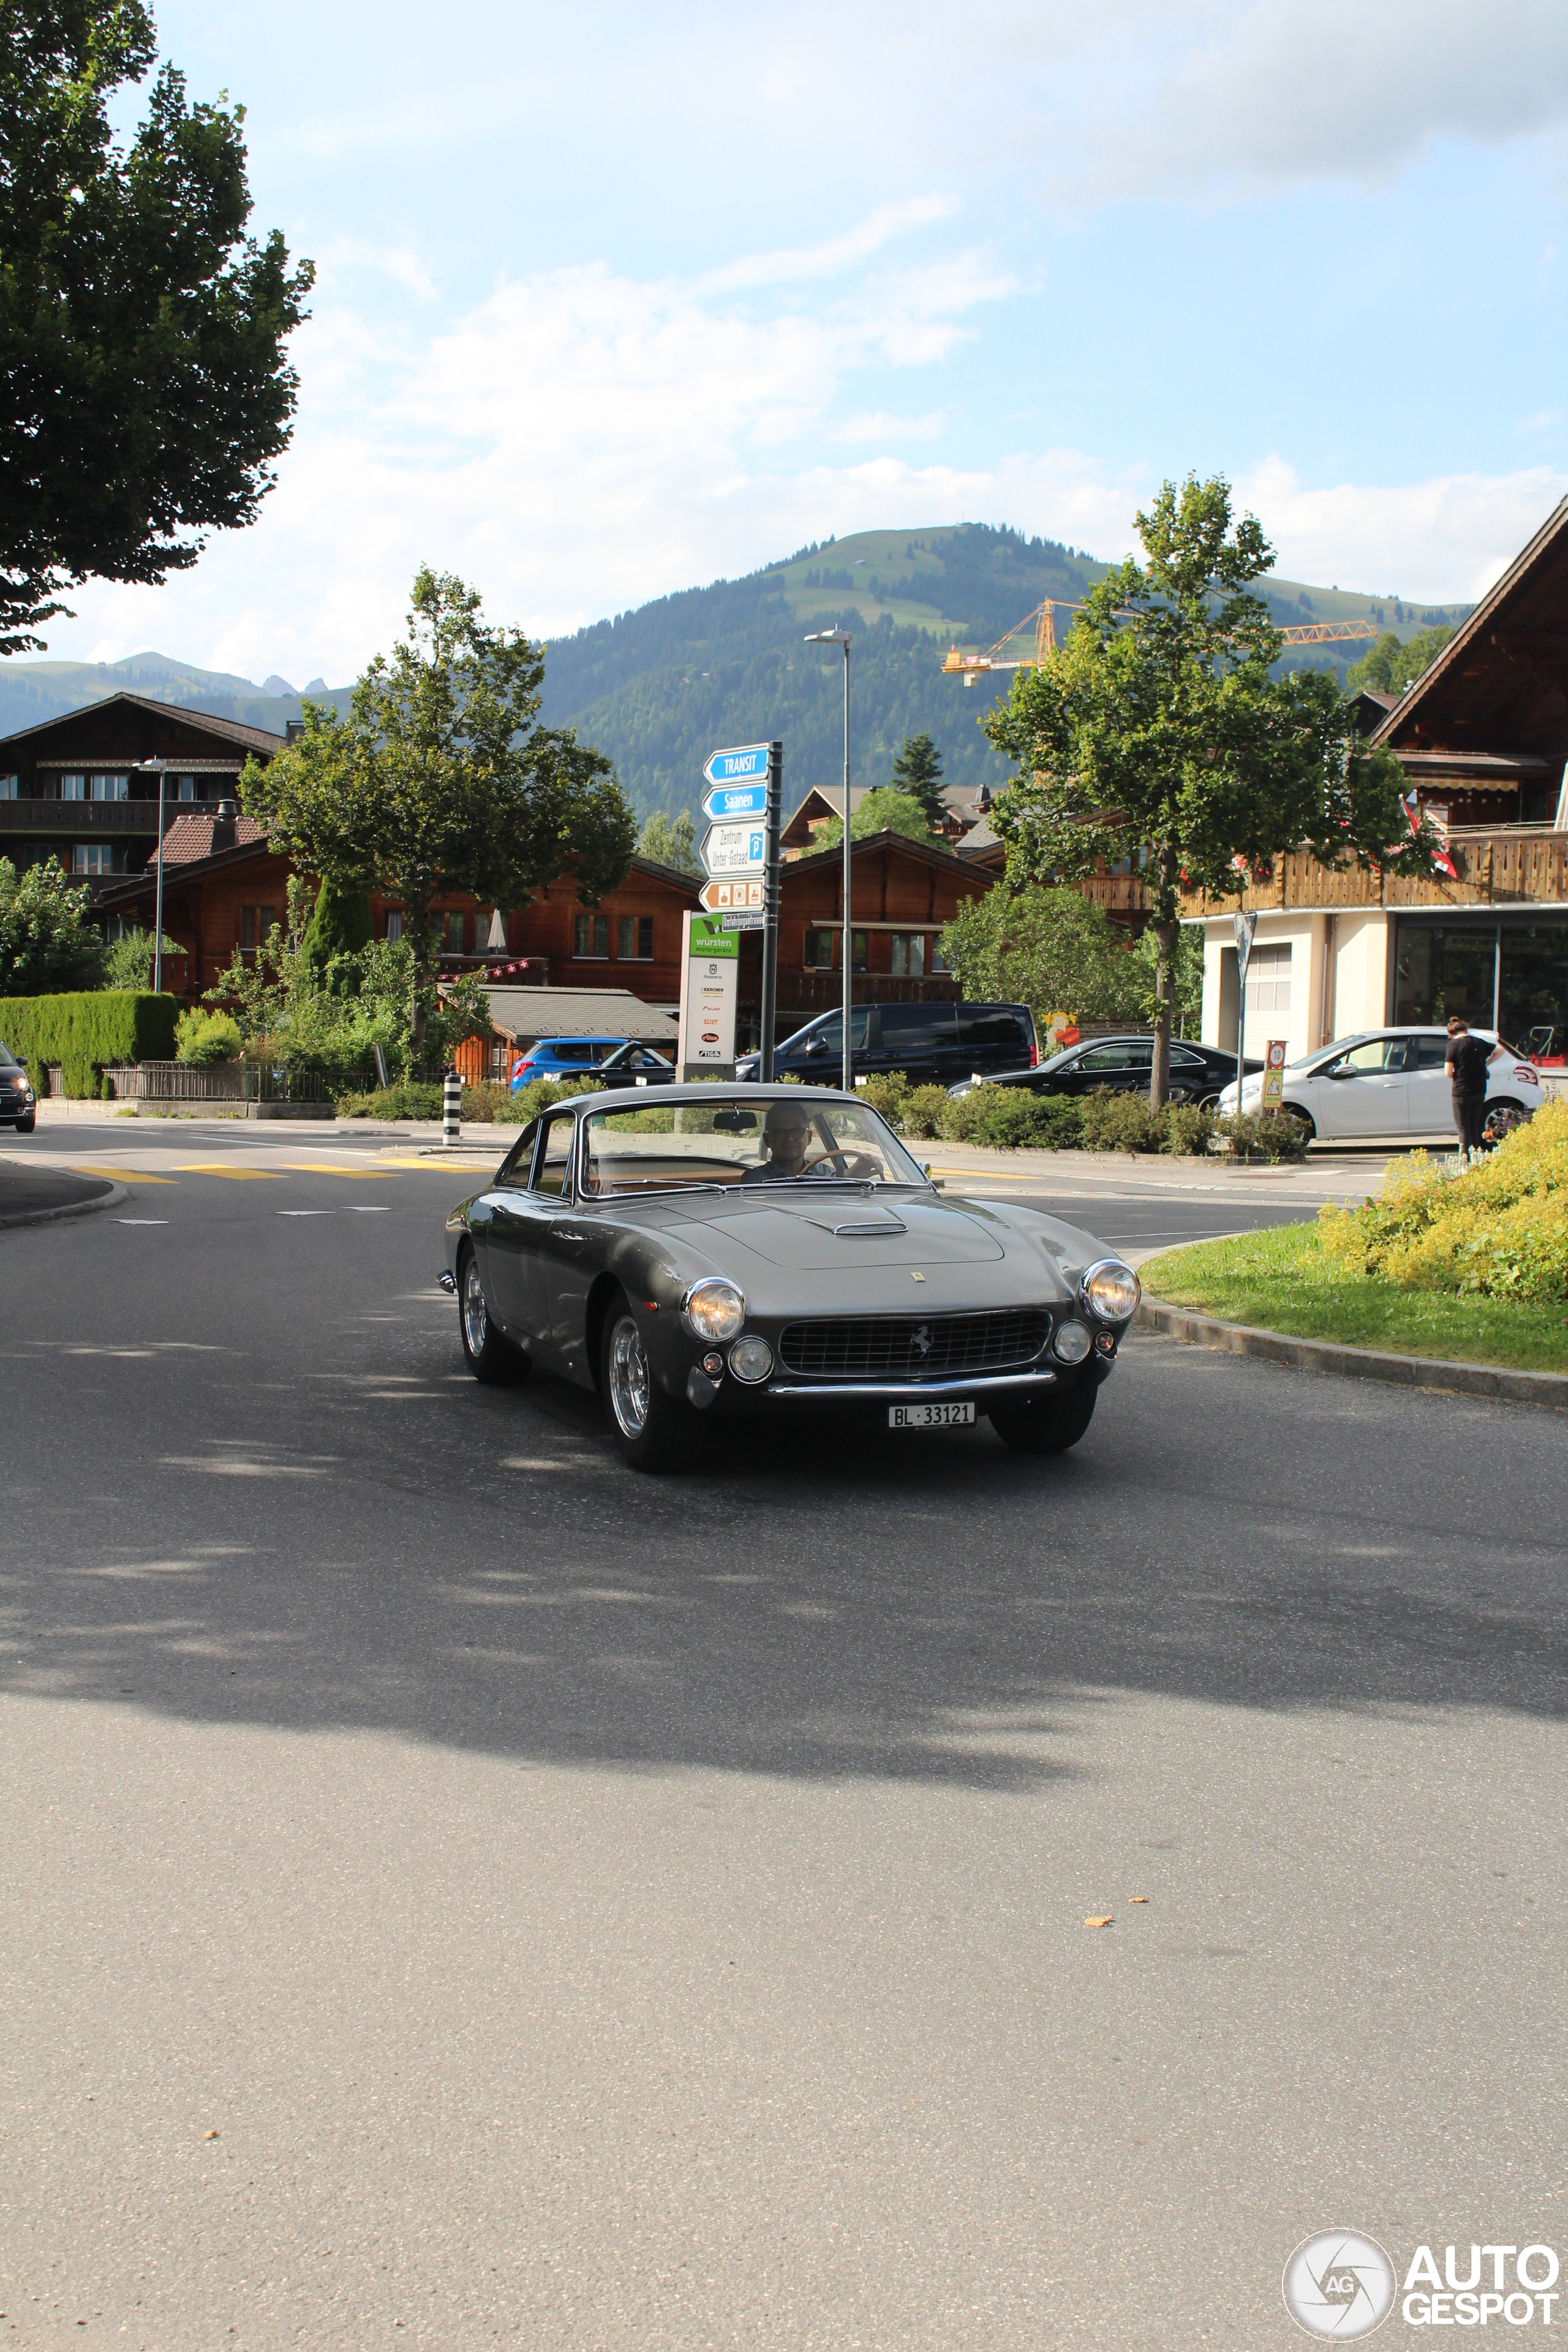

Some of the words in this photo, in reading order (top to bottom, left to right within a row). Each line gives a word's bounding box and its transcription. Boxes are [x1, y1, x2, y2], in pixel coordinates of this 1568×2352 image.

[724, 755, 757, 775] TRANSIT
[724, 794, 753, 810] Saanen
[720, 829, 742, 845] Zentrum
[712, 848, 748, 867] Unter-Gstaad
[696, 938, 732, 947] würsten
[1274, 1050, 1281, 1060] 10
[895, 1408, 913, 1426] BL
[924, 1404, 969, 1424] 33121
